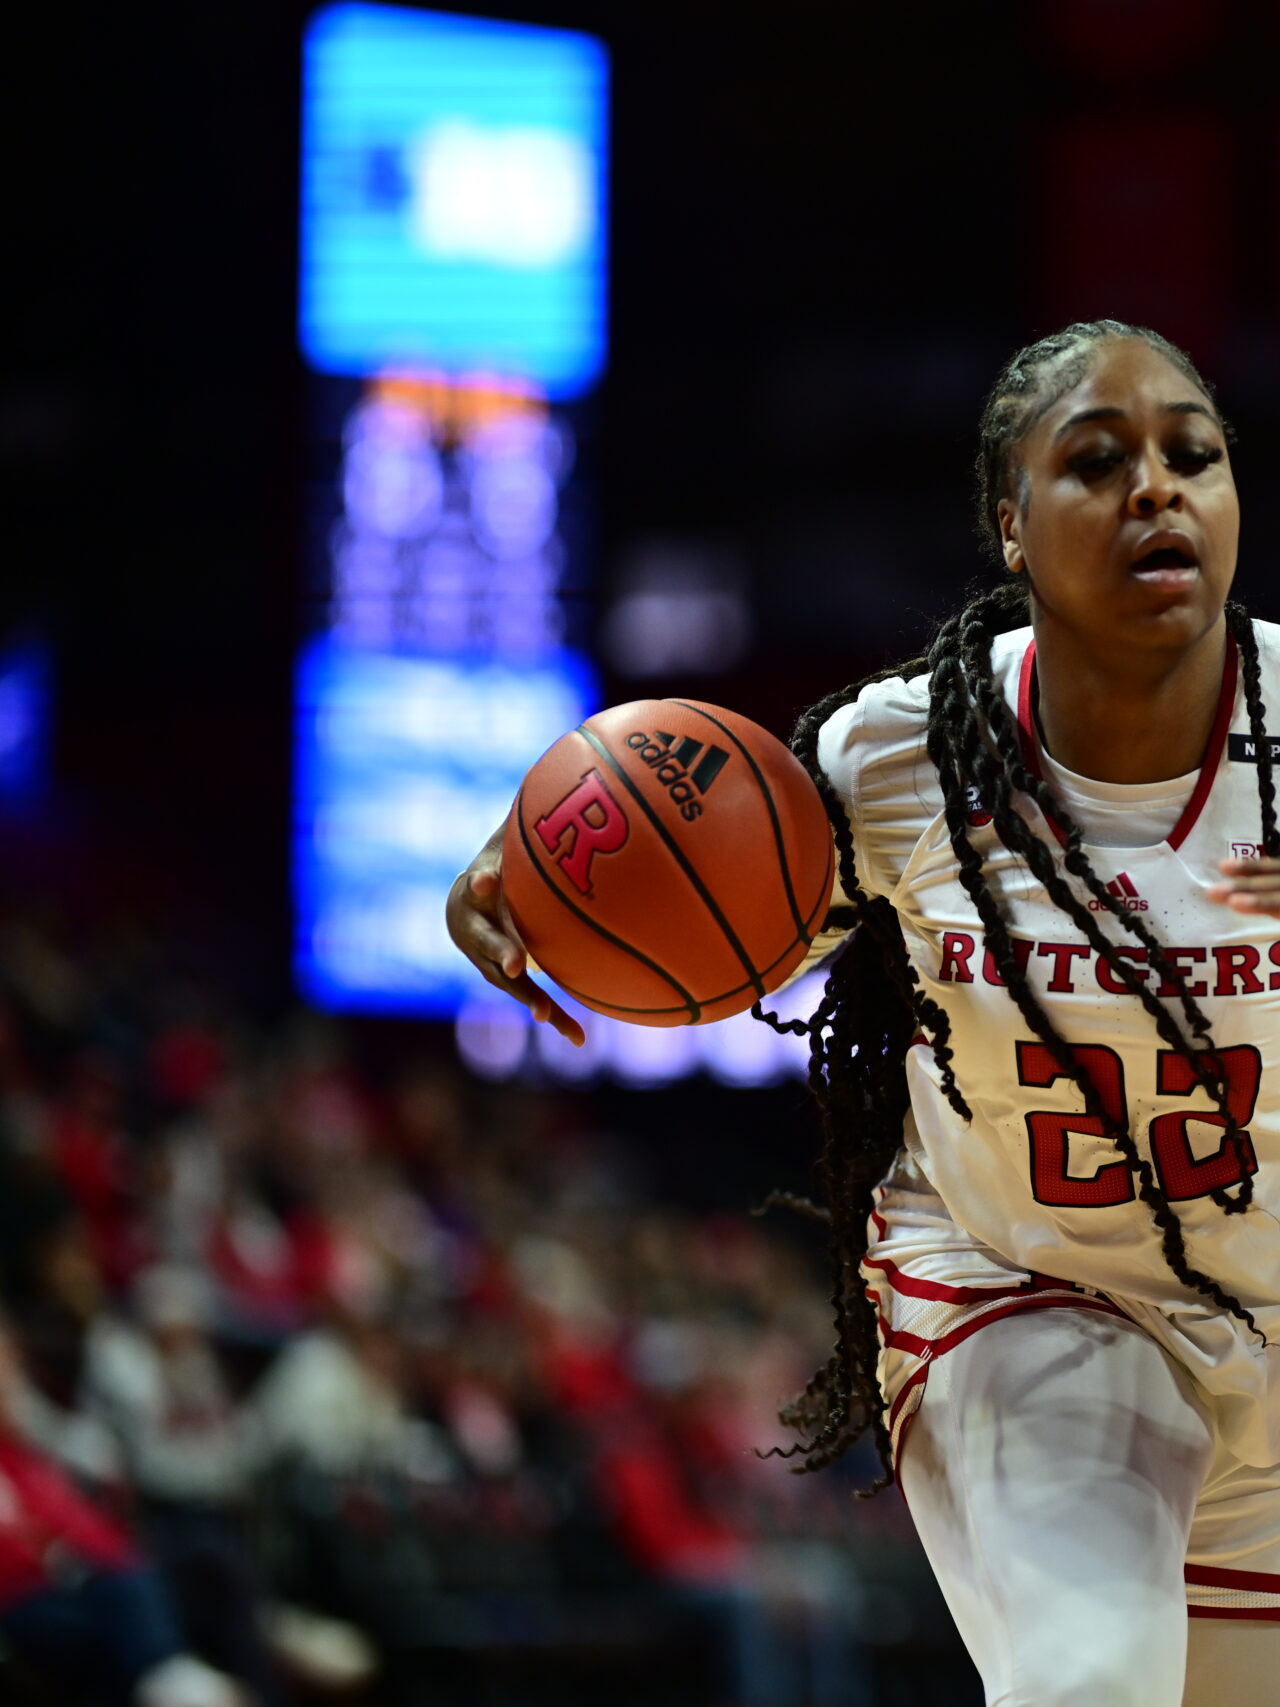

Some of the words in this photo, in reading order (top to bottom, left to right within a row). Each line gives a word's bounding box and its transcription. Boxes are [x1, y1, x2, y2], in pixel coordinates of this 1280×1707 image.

[534, 767, 630, 897] R
[625, 731, 704, 823] adidas
[1014, 1039, 1263, 1209] 22
